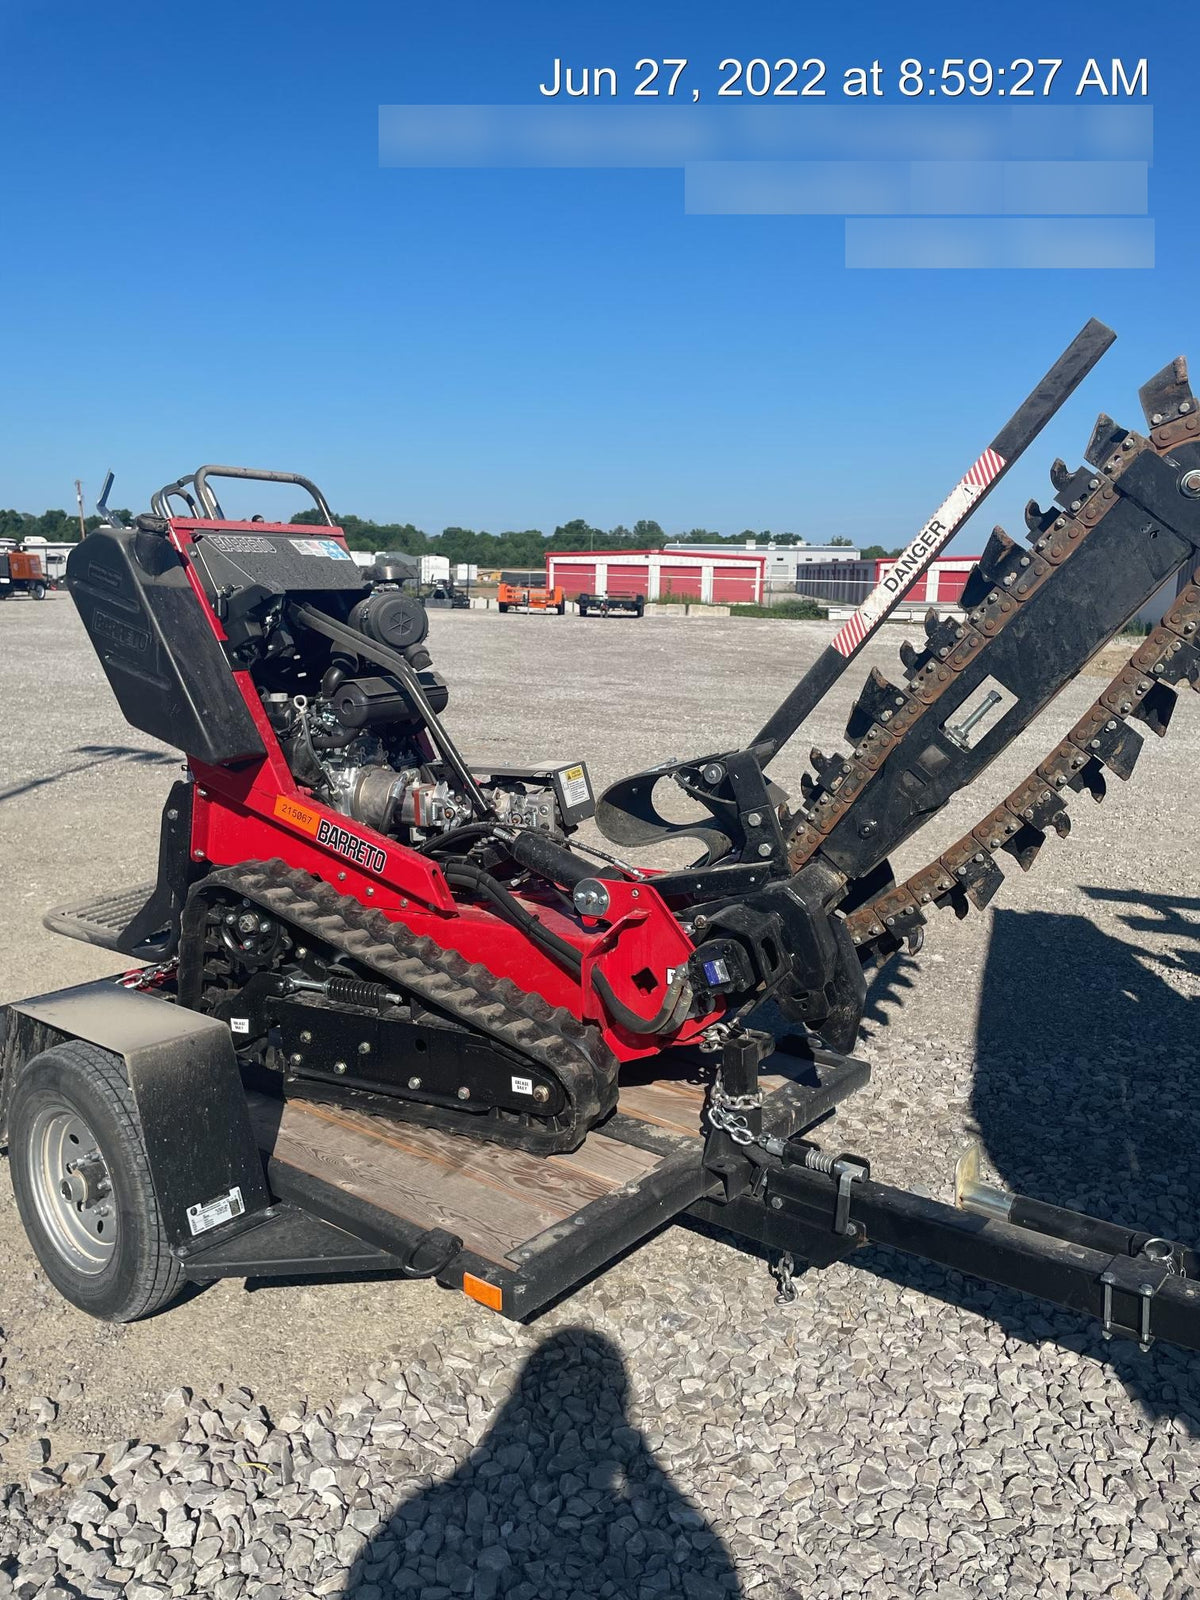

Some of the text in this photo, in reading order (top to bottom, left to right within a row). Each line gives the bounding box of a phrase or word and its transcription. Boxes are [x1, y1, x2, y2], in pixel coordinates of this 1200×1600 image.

[208, 535, 277, 553] BARRETO
[883, 520, 946, 593] DANGER
[281, 803, 313, 825] 215067
[317, 819, 387, 874] BARRETO
